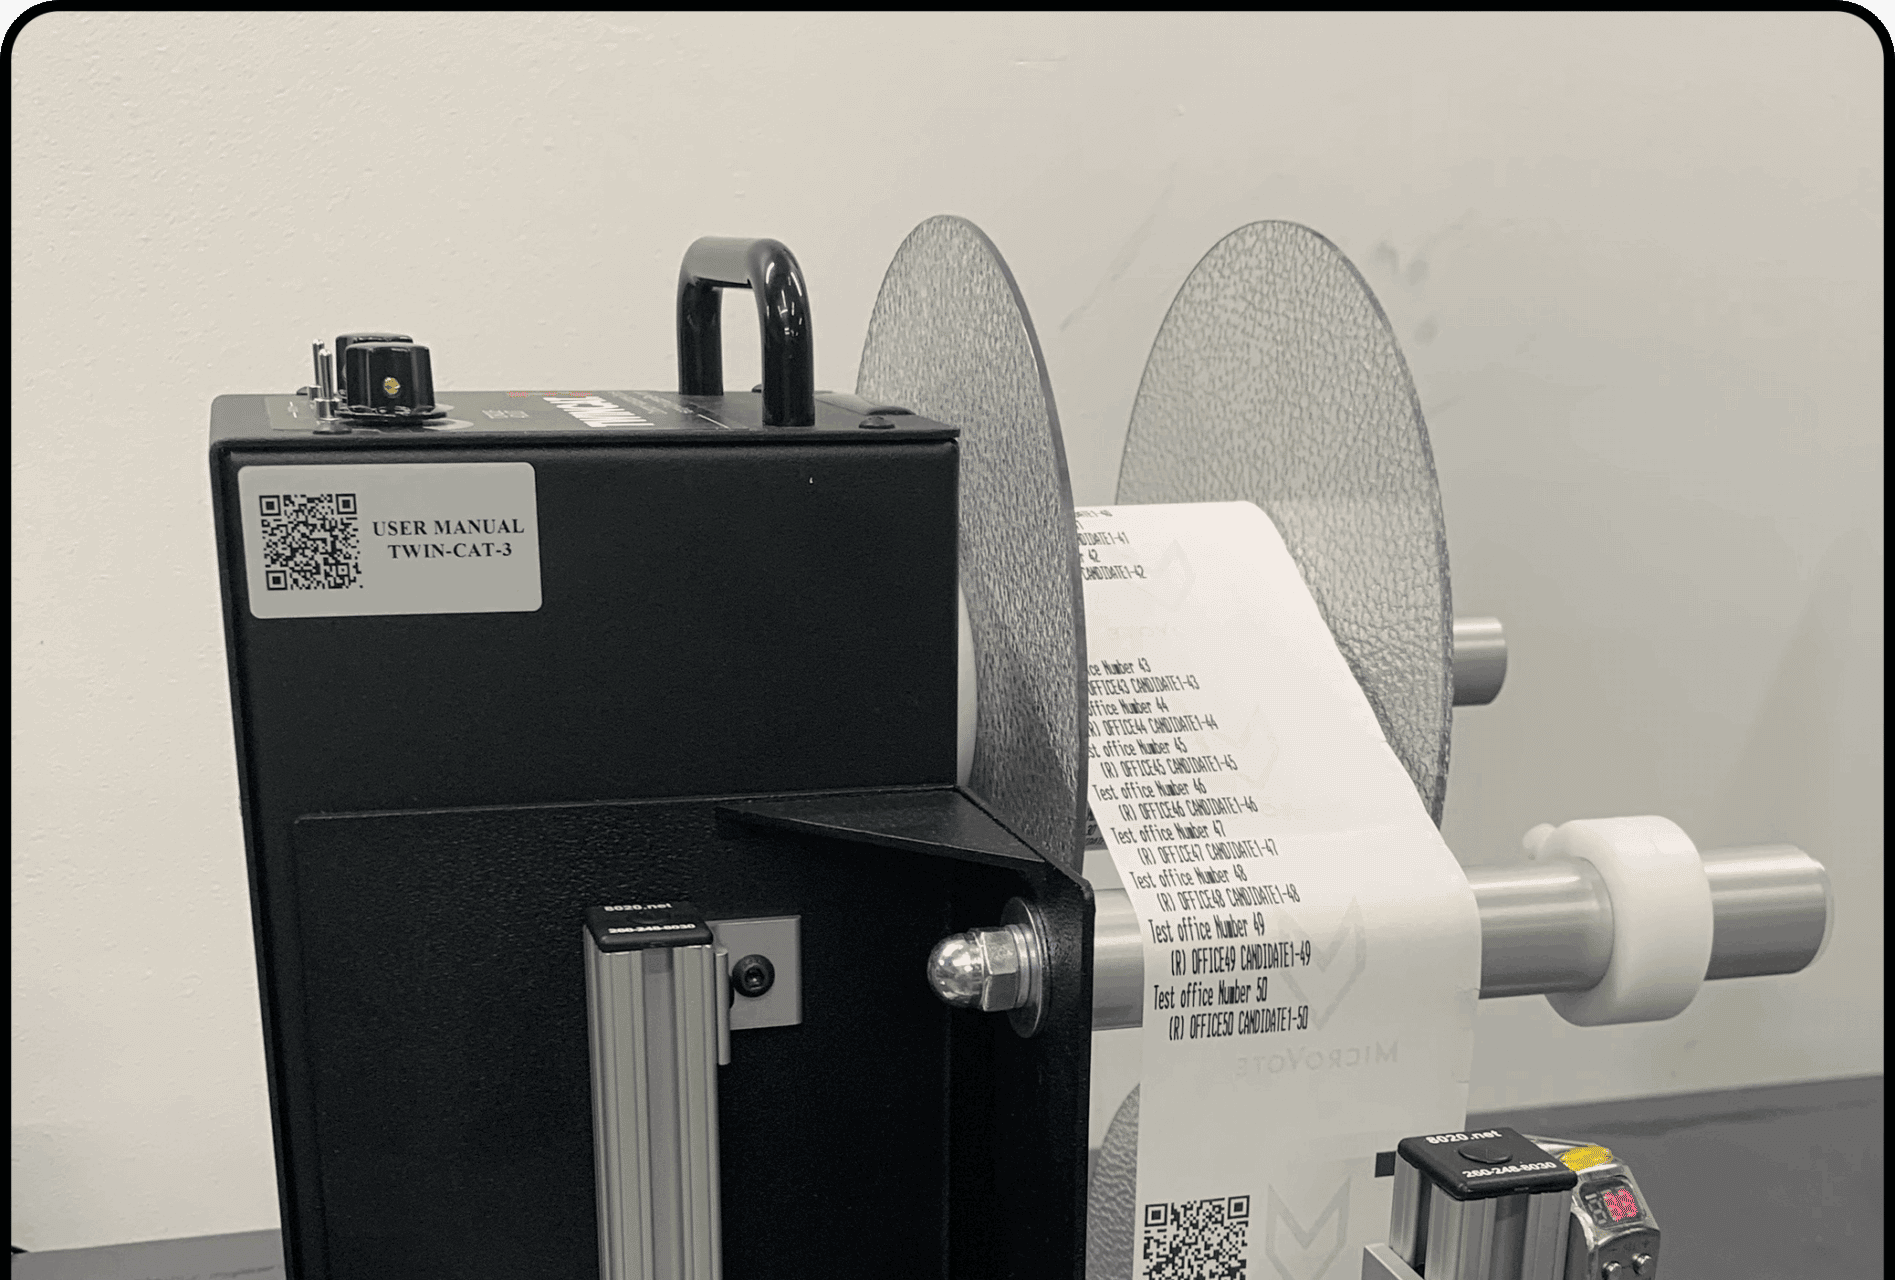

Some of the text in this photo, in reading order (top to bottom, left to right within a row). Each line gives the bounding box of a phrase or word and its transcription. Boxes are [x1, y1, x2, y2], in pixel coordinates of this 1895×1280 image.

[372, 517, 525, 537] USER MANUAL
[387, 541, 513, 560] TWIN-CAT-3
[1102, 660, 1135, 676] Number
[1138, 657, 1152, 673] 43
[1131, 675, 1200, 694] CANDIDATE1-43
[1118, 698, 1152, 715] Number
[1155, 696, 1170, 713] 44
[1088, 714, 1219, 737] R) OFFICE44 CANDIDATE1-44
[1102, 740, 1137, 757] office
[1136, 738, 1170, 755] Number
[1173, 737, 1188, 753] 45
[1100, 754, 1238, 779] (R) OFFICE45 CANDIDATE1-45
[1092, 778, 1207, 801] Test office Number 46
[1118, 796, 1259, 822] (R) OFFICE46 CANDIDATE1-46
[1110, 827, 1137, 845] Test
[1139, 825, 1175, 843] office
[1174, 822, 1210, 840] Number
[1212, 820, 1227, 838] 47
[1137, 838, 1279, 866] (R) OFFICE47 CANDIDATE1-47
[1129, 864, 1248, 890] Test office Number 48
[603, 902, 673, 912] 8020.net
[1156, 883, 1300, 912] (R) OFFICE48 CANDIDATE1-48
[1148, 911, 1266, 944] Test office Number 49
[1170, 940, 1312, 976] (R) OFFICE49 CANDIDATE1-49
[1153, 976, 1268, 1010] Test office Number 50
[1169, 1005, 1309, 1041] (R) OFFICE50 CANDIDATE1-50
[1425, 1129, 1503, 1144] 8020.net
[1462, 1161, 1557, 1179] 260-248-8030
